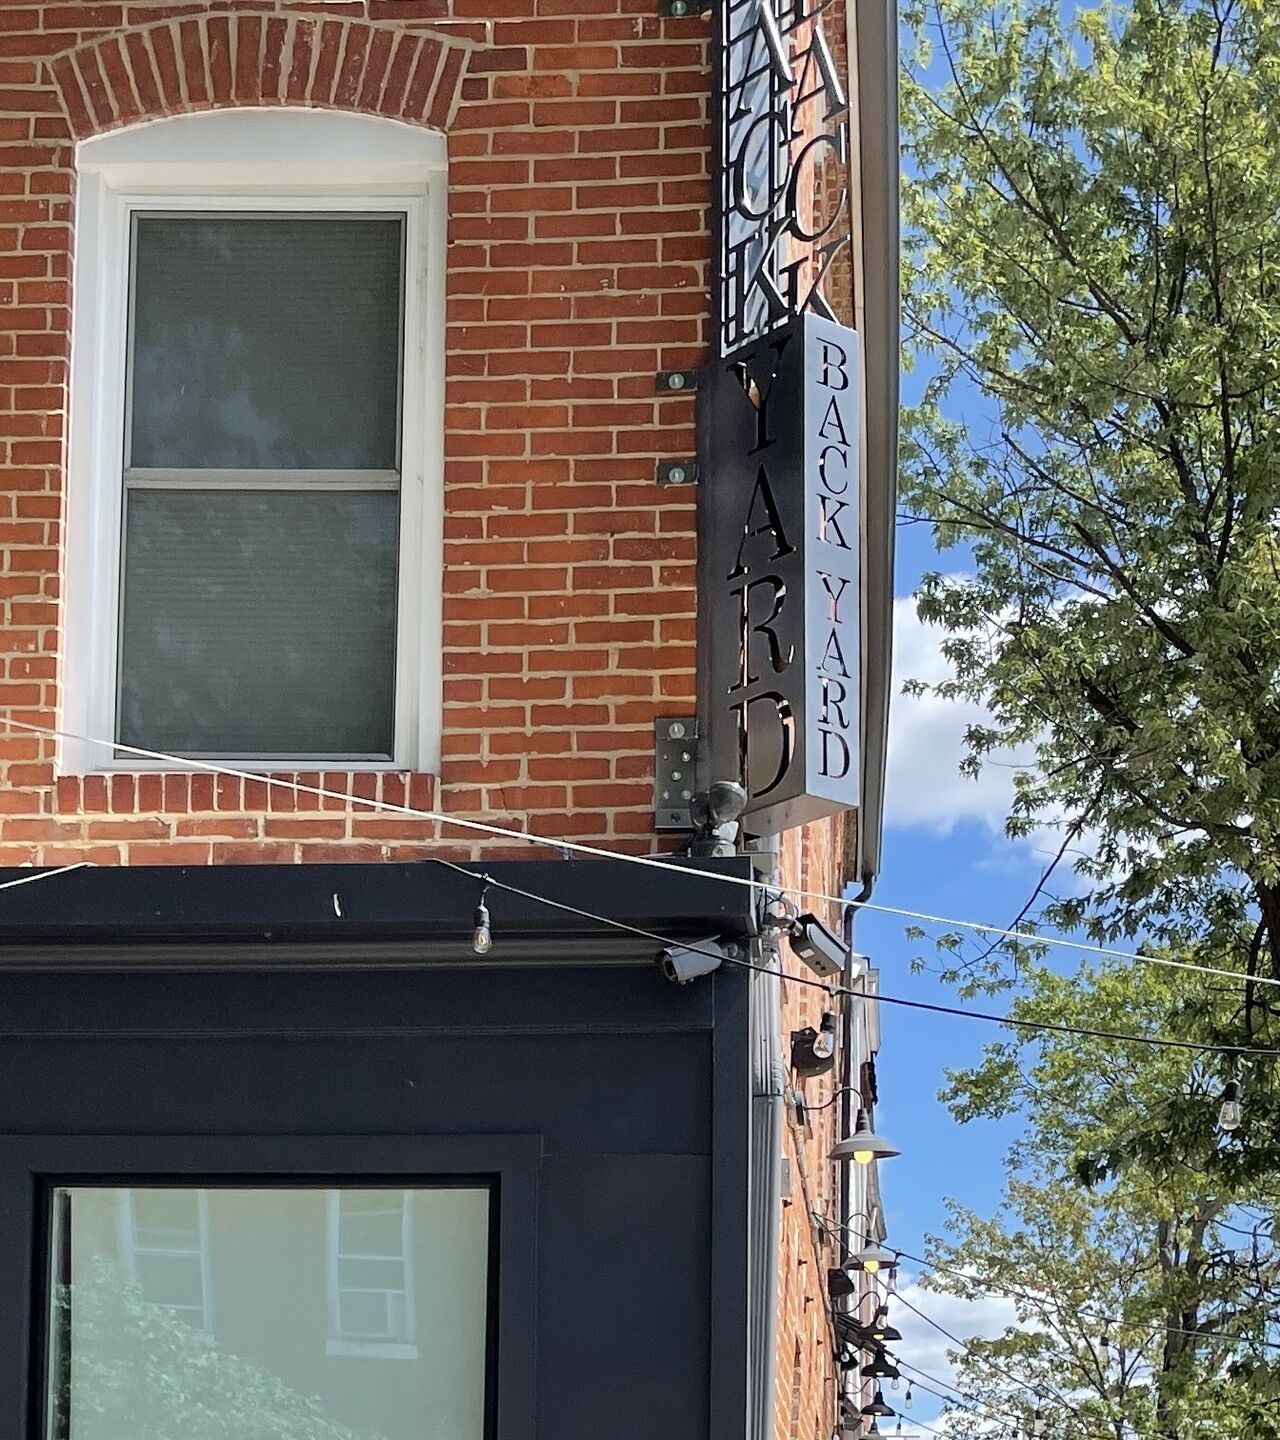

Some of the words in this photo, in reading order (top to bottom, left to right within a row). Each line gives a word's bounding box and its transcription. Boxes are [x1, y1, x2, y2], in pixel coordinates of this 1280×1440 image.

[816, 337, 851, 551] BACK
[726, 333, 798, 799] YARD
[816, 570, 851, 780] YARD
